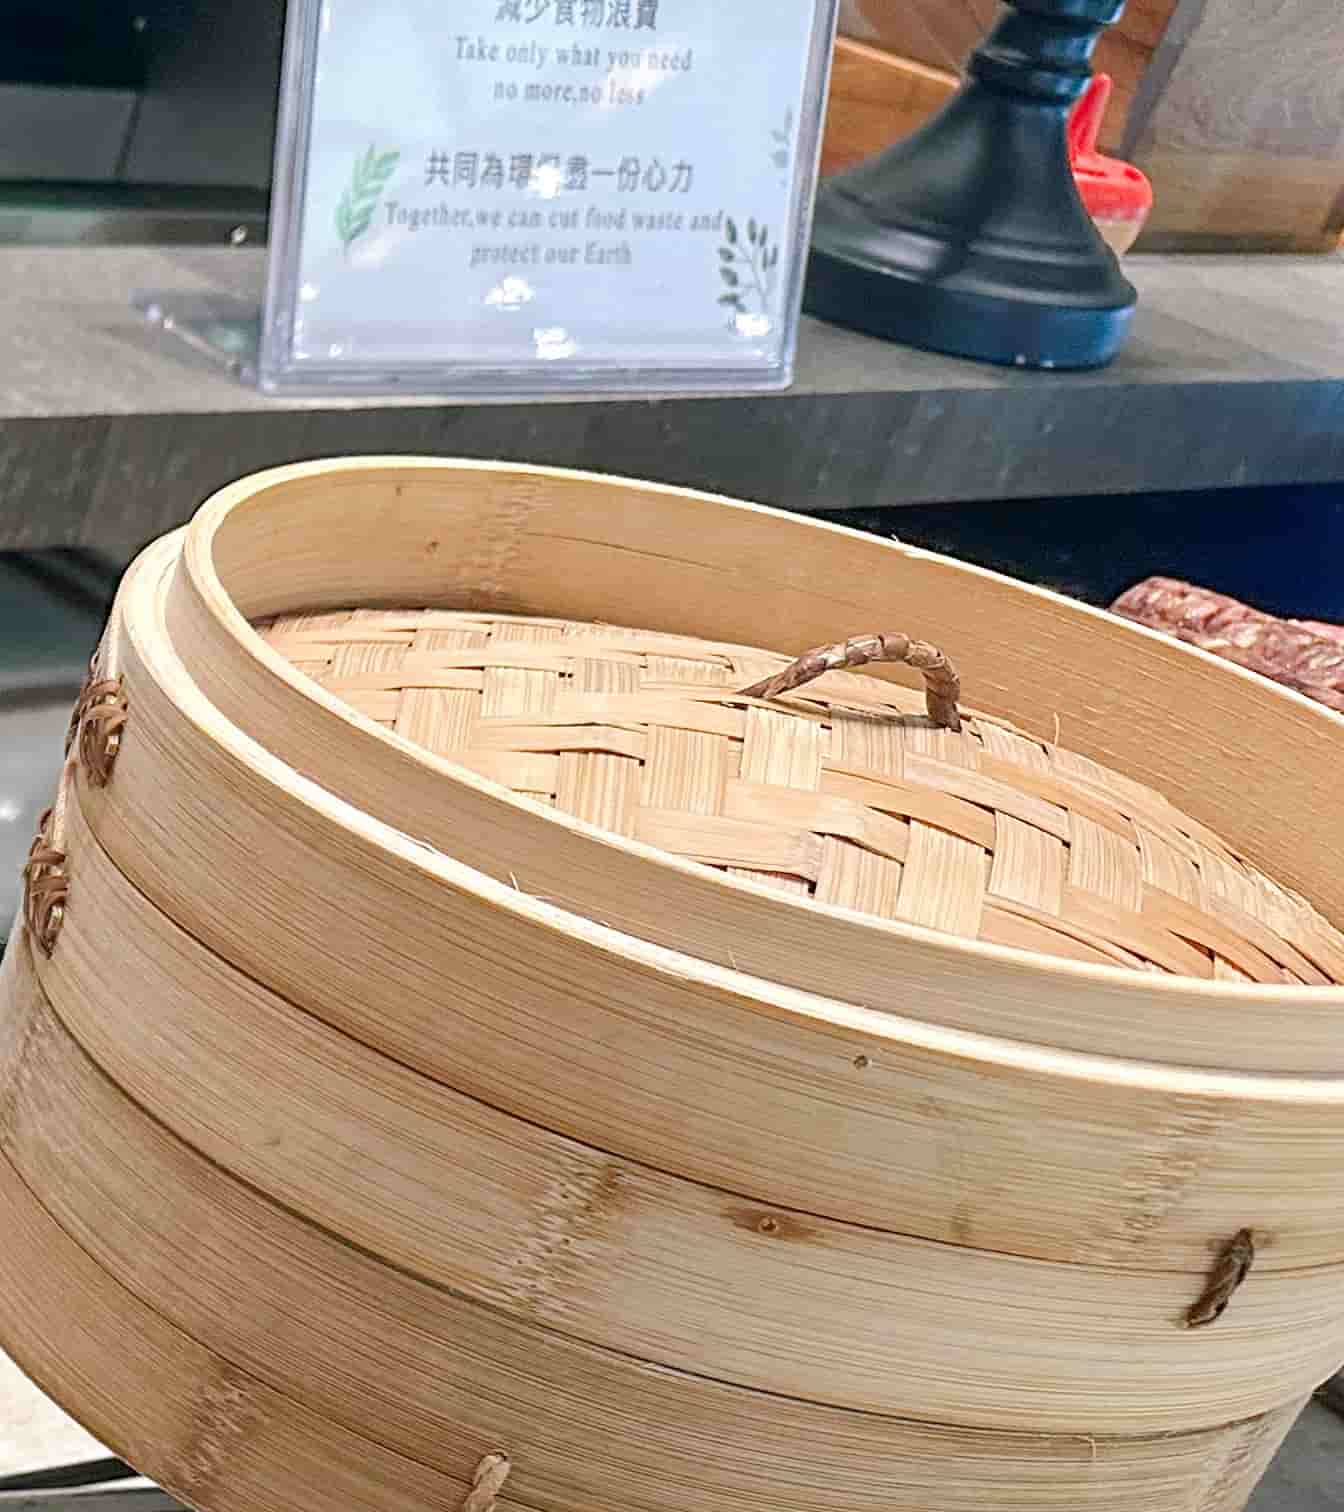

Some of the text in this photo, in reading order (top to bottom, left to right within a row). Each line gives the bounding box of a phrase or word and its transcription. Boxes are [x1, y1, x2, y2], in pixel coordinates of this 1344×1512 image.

[455, 36, 499, 62] Take
[506, 40, 546, 70] only
[557, 43, 600, 67] what
[493, 81, 518, 100] no
[508, 210, 541, 229] can
[584, 205, 624, 230] food
[632, 210, 683, 231] waste
[689, 208, 724, 232] and
[469, 240, 633, 268] protect our Earth
